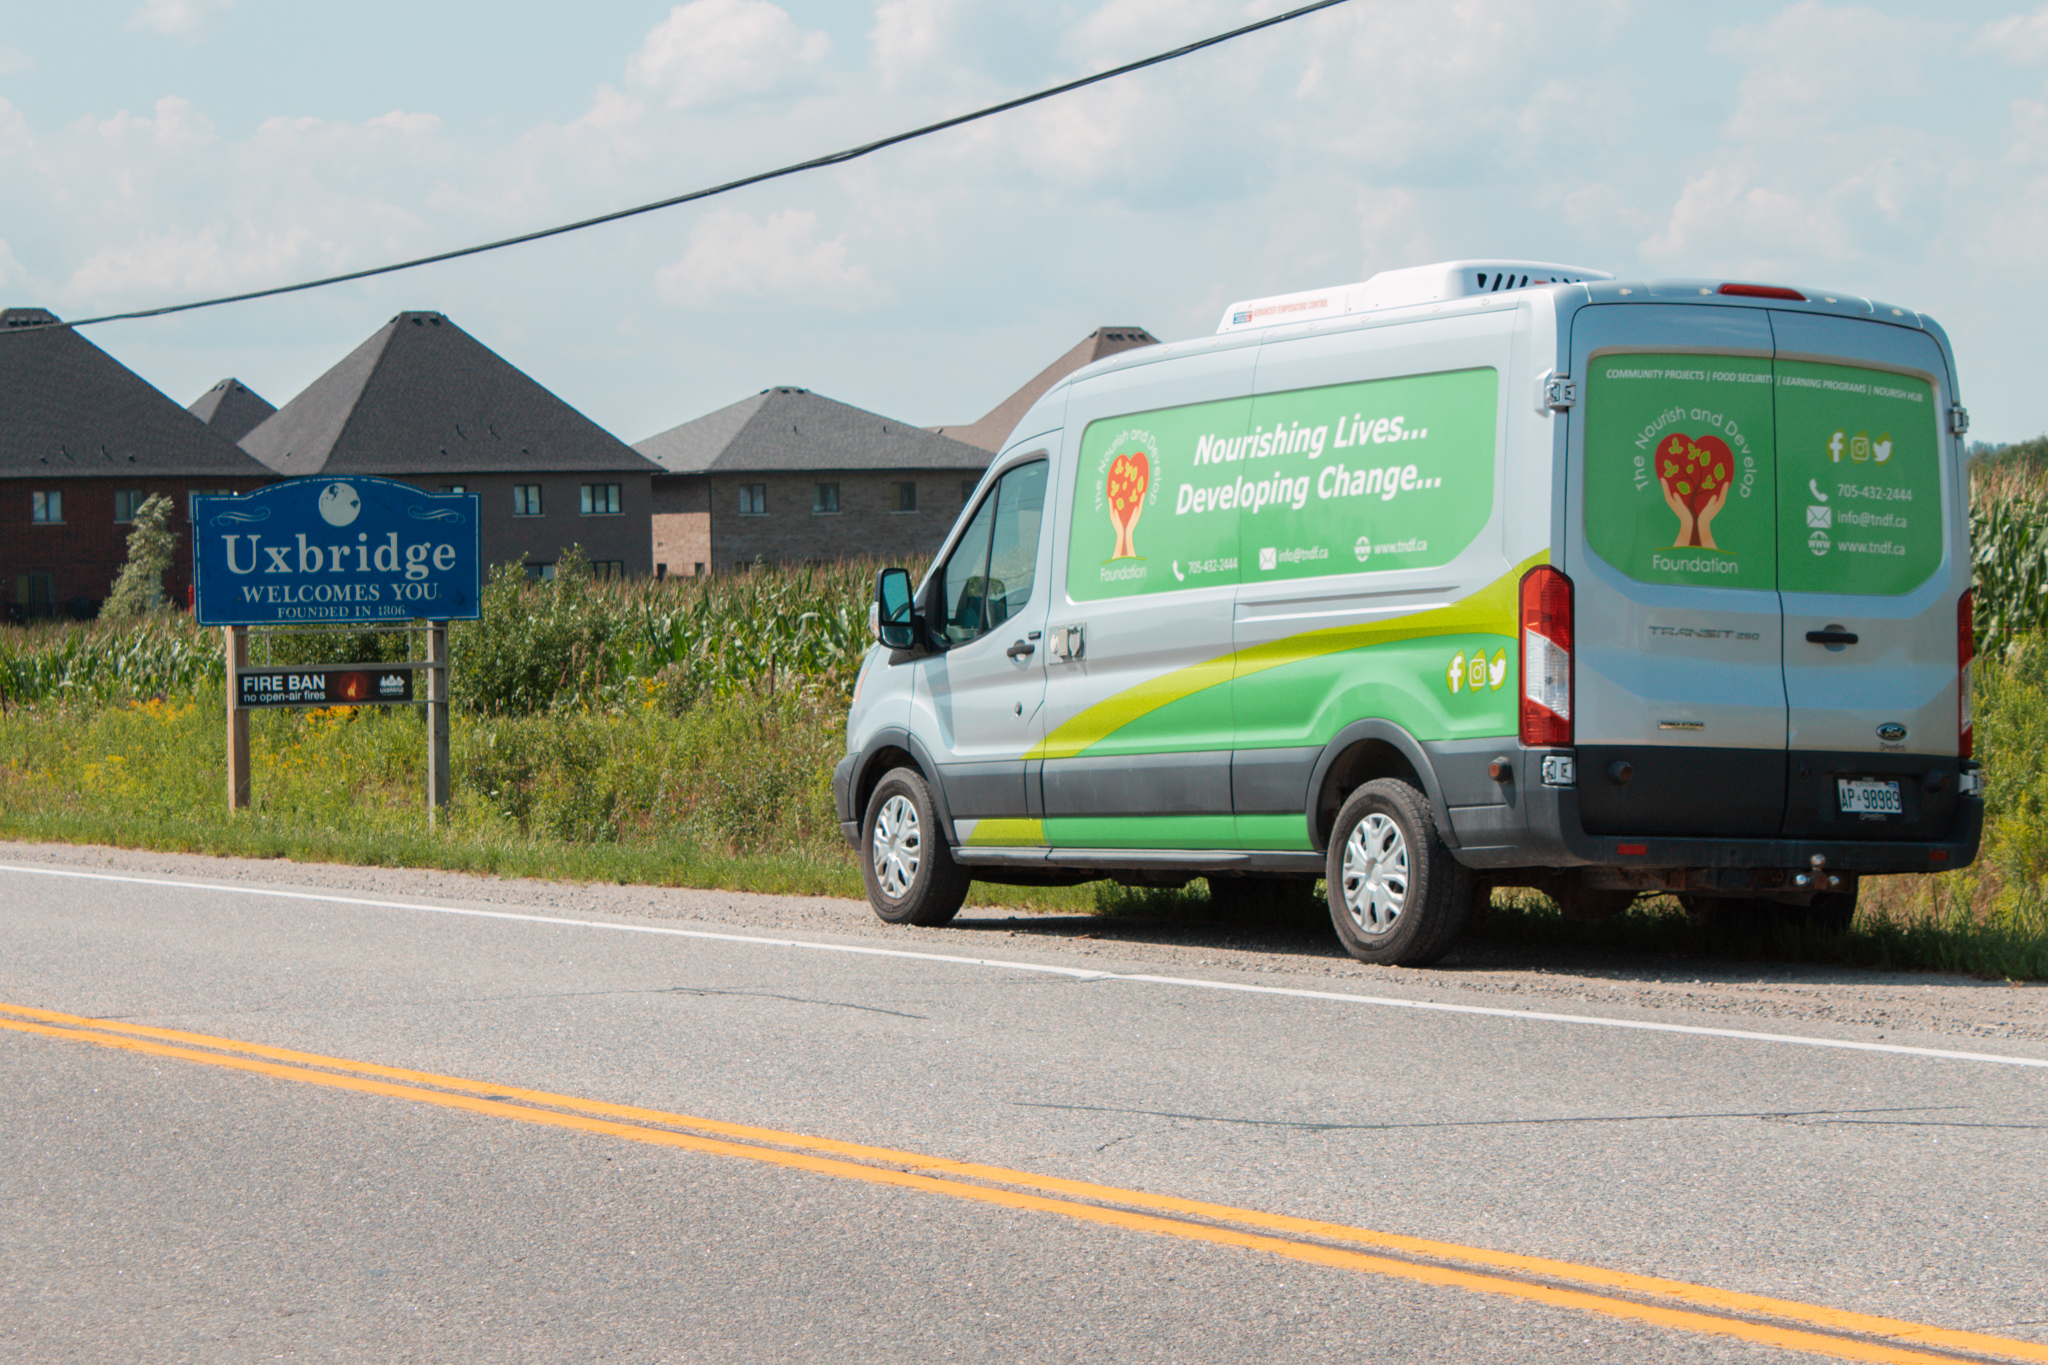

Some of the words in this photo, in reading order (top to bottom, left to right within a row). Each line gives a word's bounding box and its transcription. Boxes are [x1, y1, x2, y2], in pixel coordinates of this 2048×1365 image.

[1606, 369, 1663, 379] COMMUNITY
[1665, 370, 1705, 380] PROJECTS
[1712, 372, 1736, 381] FOOD
[1737, 373, 1775, 384] SECURITY
[1782, 376, 1821, 388] LEARNING
[1822, 379, 1867, 393] PROGRAMS
[1873, 386, 1907, 400] NOURISH
[1908, 392, 1923, 402] HUB
[1690, 407, 1723, 427] and
[1634, 406, 1687, 449] Nourish
[1193, 420, 1328, 466] Nourishing
[1333, 413, 1428, 448] Lives...
[1725, 420, 1758, 498] Develop
[1633, 456, 1649, 491] The
[1175, 471, 1310, 515] Developing
[1317, 464, 1441, 501] Change...
[1838, 483, 1912, 501] 705-432-2444
[1838, 510, 1907, 528] info@tndf.ca
[1278, 546, 1329, 563] info@tndf.ca
[1374, 537, 1428, 554] www.tndf.ca
[1838, 540, 1906, 556] www.tndf.ca
[221, 532, 456, 580] Uxbridge
[1187, 557, 1238, 574] 705-432-2444
[1653, 554, 1739, 574] Foundation
[1101, 565, 1146, 582] Foundation
[241, 584, 380, 603] WELCOMES
[391, 582, 439, 601] YOU
[277, 606, 349, 619] FOUNDED
[355, 605, 371, 617] IN
[378, 604, 405, 616] 1806
[1648, 625, 1735, 639] TRANSIT
[243, 675, 283, 692] FIRE
[288, 674, 325, 691] BAN
[243, 693, 257, 702] no
[258, 691, 301, 704] open-air
[303, 690, 326, 701] fires
[1842, 788, 1855, 808] AP
[1863, 789, 1901, 810] 98989
